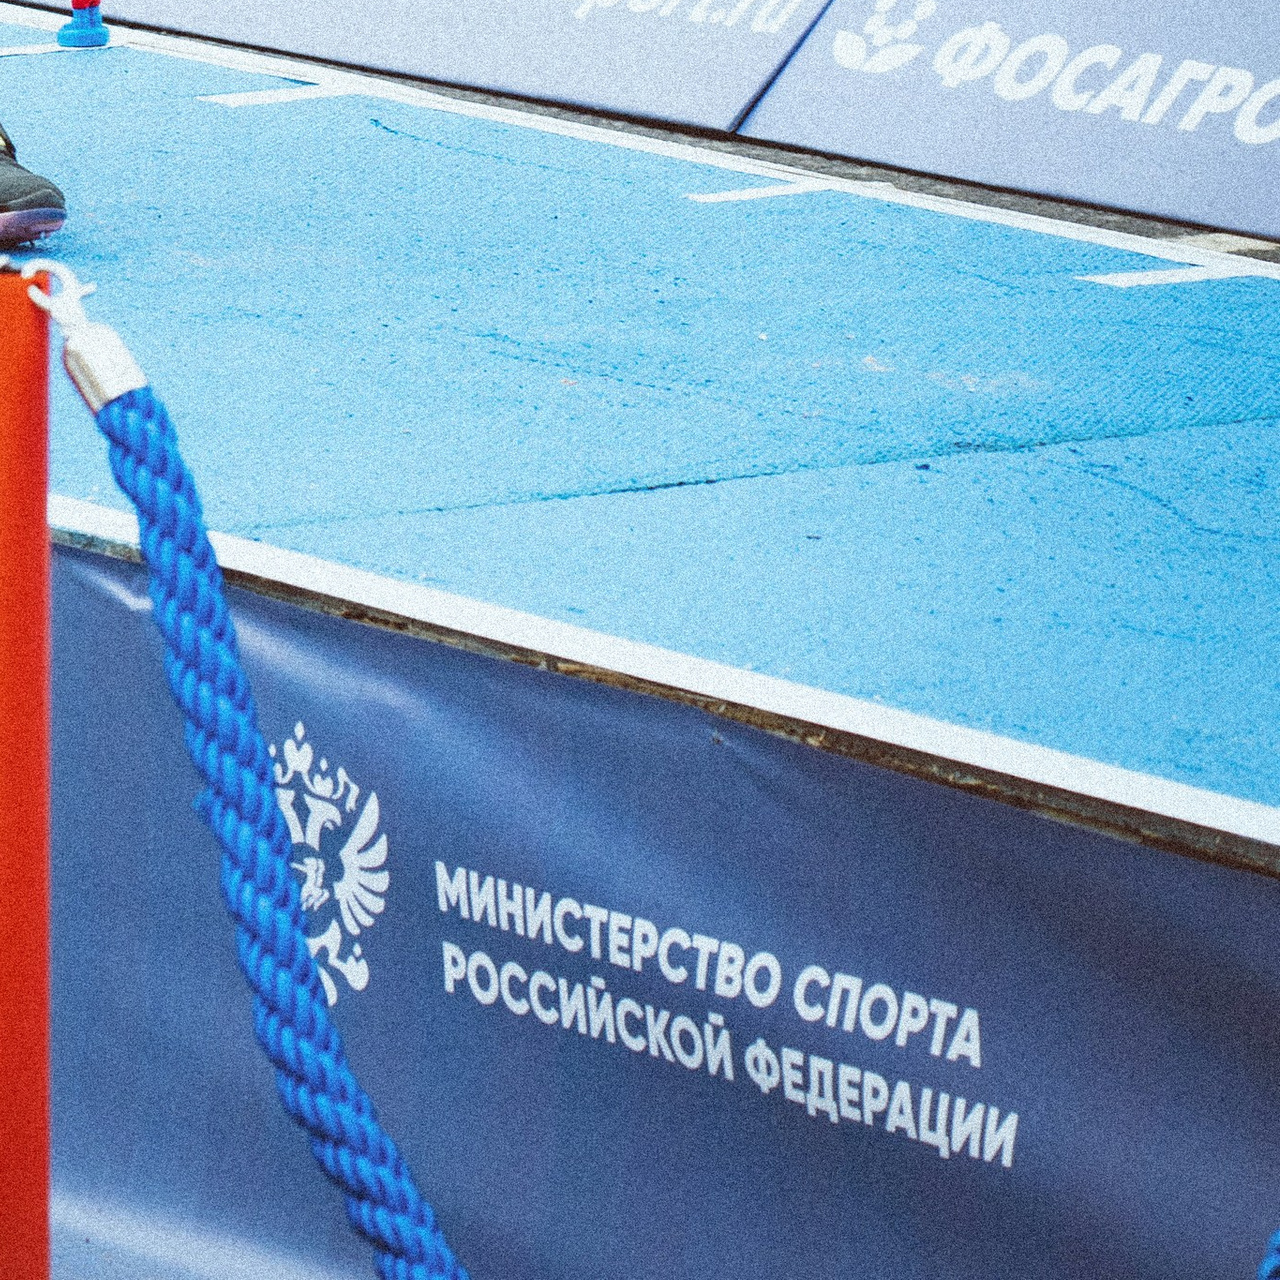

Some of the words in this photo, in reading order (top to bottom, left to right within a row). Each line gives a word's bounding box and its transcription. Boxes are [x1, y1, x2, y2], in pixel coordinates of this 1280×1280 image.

[933, 21, 1280, 146] ФОСАГРО
[434, 860, 781, 1008] МИНИСТЕРСТВО
[793, 964, 983, 1068] СПОРТА
[442, 942, 734, 1082] РОССИЙСКОЙ
[744, 1039, 1019, 1169] ФЕДЕРАЦИИ
